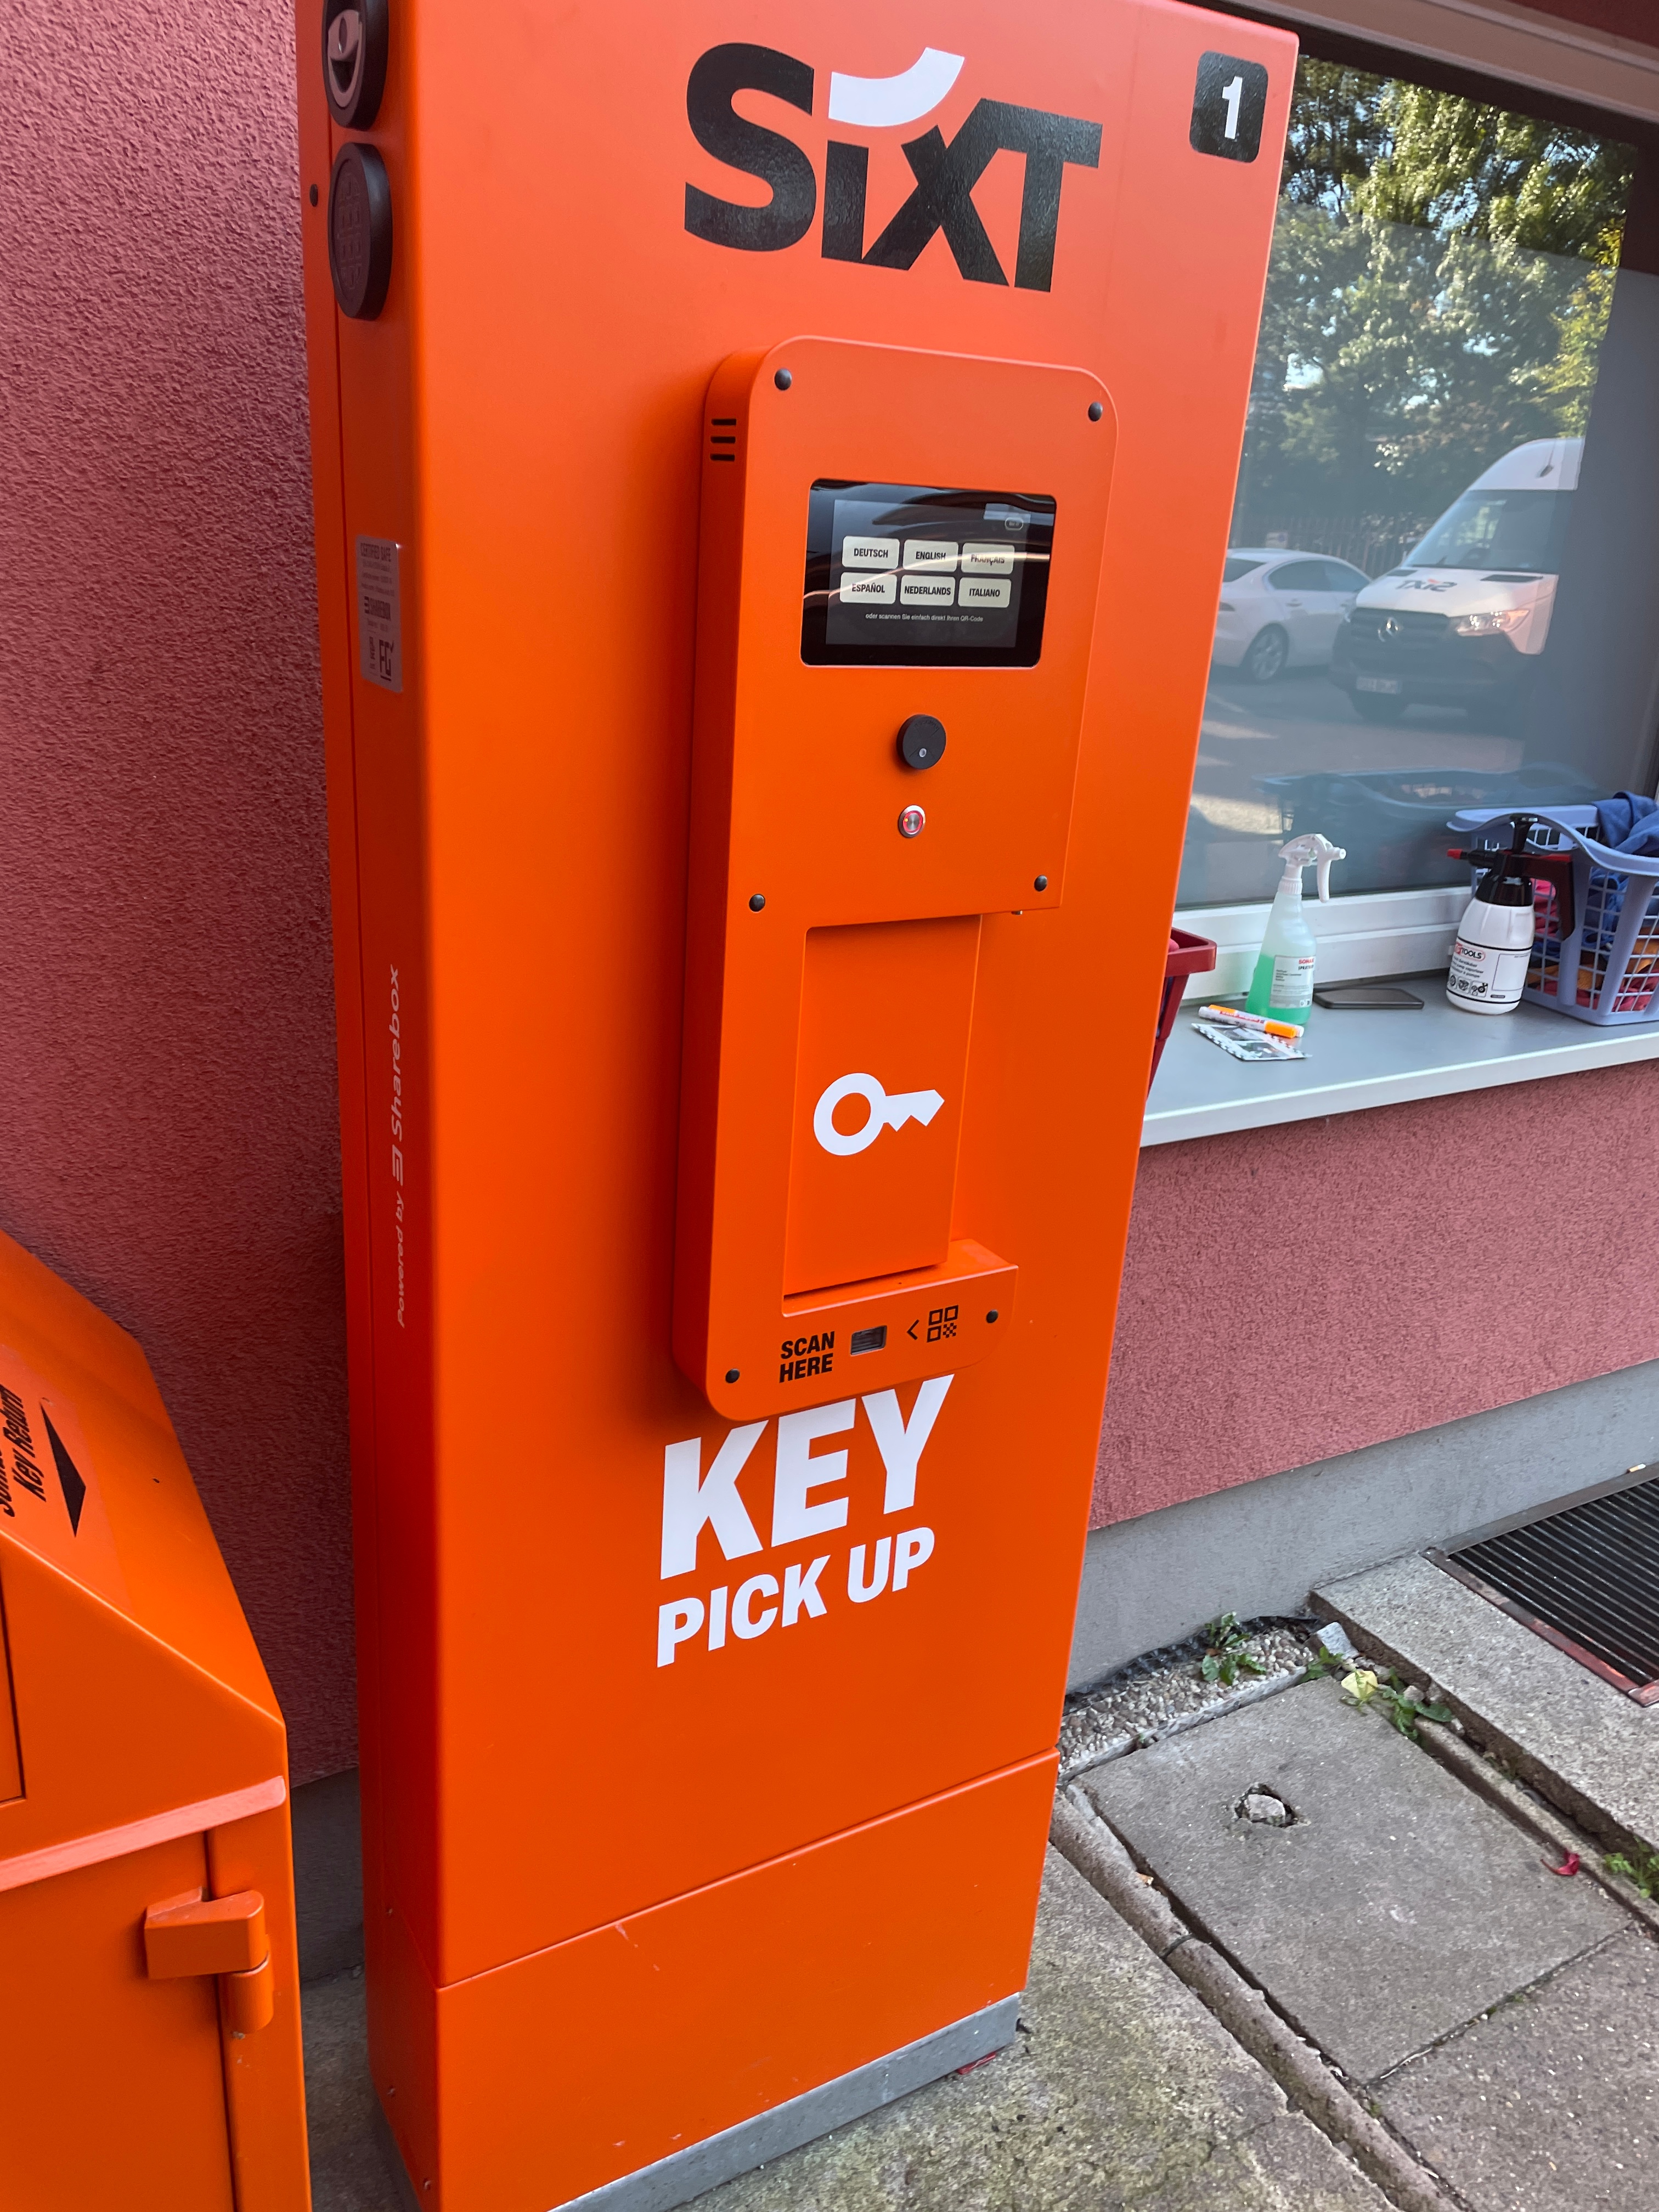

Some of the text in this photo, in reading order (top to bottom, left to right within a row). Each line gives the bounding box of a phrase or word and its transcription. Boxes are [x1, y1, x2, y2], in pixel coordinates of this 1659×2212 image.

[1222, 75, 1244, 140] 1
[854, 548, 888, 558] DEUTSCH
[915, 551, 946, 560] ENGLISH
[851, 582, 885, 593] ESPAÑOL
[904, 585, 951, 596] NEDERLANDS
[969, 588, 1000, 597] ITALIANO
[389, 964, 405, 1329] Powered by Sharebox
[781, 1331, 835, 1359] SCAN
[779, 1353, 833, 1383] HERE
[12, 1448, 47, 1503] Key
[661, 1374, 955, 1580] KEY
[657, 1527, 935, 1668] PICK UP
